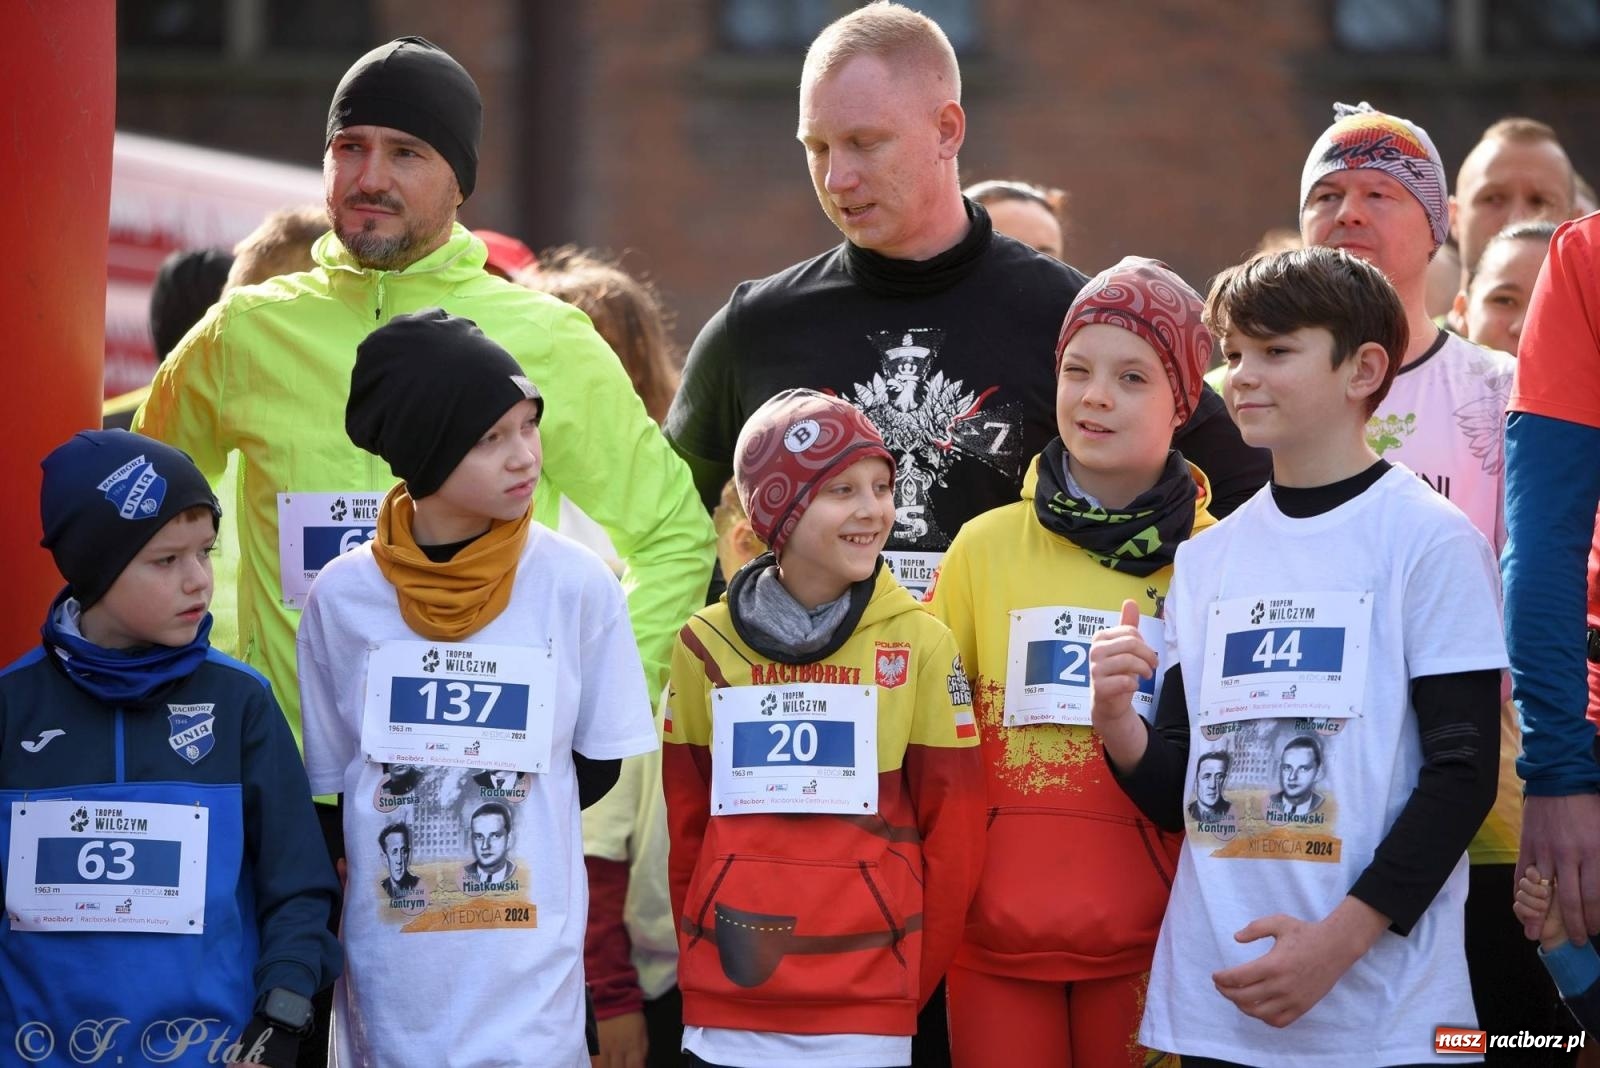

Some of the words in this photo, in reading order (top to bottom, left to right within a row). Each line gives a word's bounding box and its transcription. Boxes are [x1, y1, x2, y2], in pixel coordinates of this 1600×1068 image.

[1416, 472, 1450, 500] NI
[124, 474, 153, 515] UNIA
[352, 499, 377, 507] TROPEM
[353, 507, 378, 519] WILC
[900, 559, 925, 567] TROPEM
[901, 567, 934, 579] WILCZ
[1078, 614, 1104, 624] TROPEM
[1269, 607, 1315, 620] WILCZYM
[875, 641, 911, 649] POLSKA
[1252, 629, 1303, 668] 44
[446, 650, 473, 658] TROPEM
[446, 659, 497, 674] WILCZYM
[418, 681, 502, 724] 137
[782, 692, 804, 700] TROPEM
[782, 700, 827, 713] WILCZYM
[173, 724, 210, 747] UNIA
[766, 722, 818, 762] 20
[480, 786, 526, 798] Rodowicz
[95, 808, 122, 817] TROPEM
[1266, 811, 1325, 825] Miatkowski
[95, 818, 148, 832] WILCZYM
[1197, 823, 1236, 835] Kontrym
[1263, 839, 1302, 854] EDYCJA
[1306, 841, 1333, 856] 2024
[77, 840, 135, 881] 63
[463, 880, 519, 892] Miatkowski
[459, 909, 501, 924] EDYCJA
[505, 908, 530, 922] 2024
